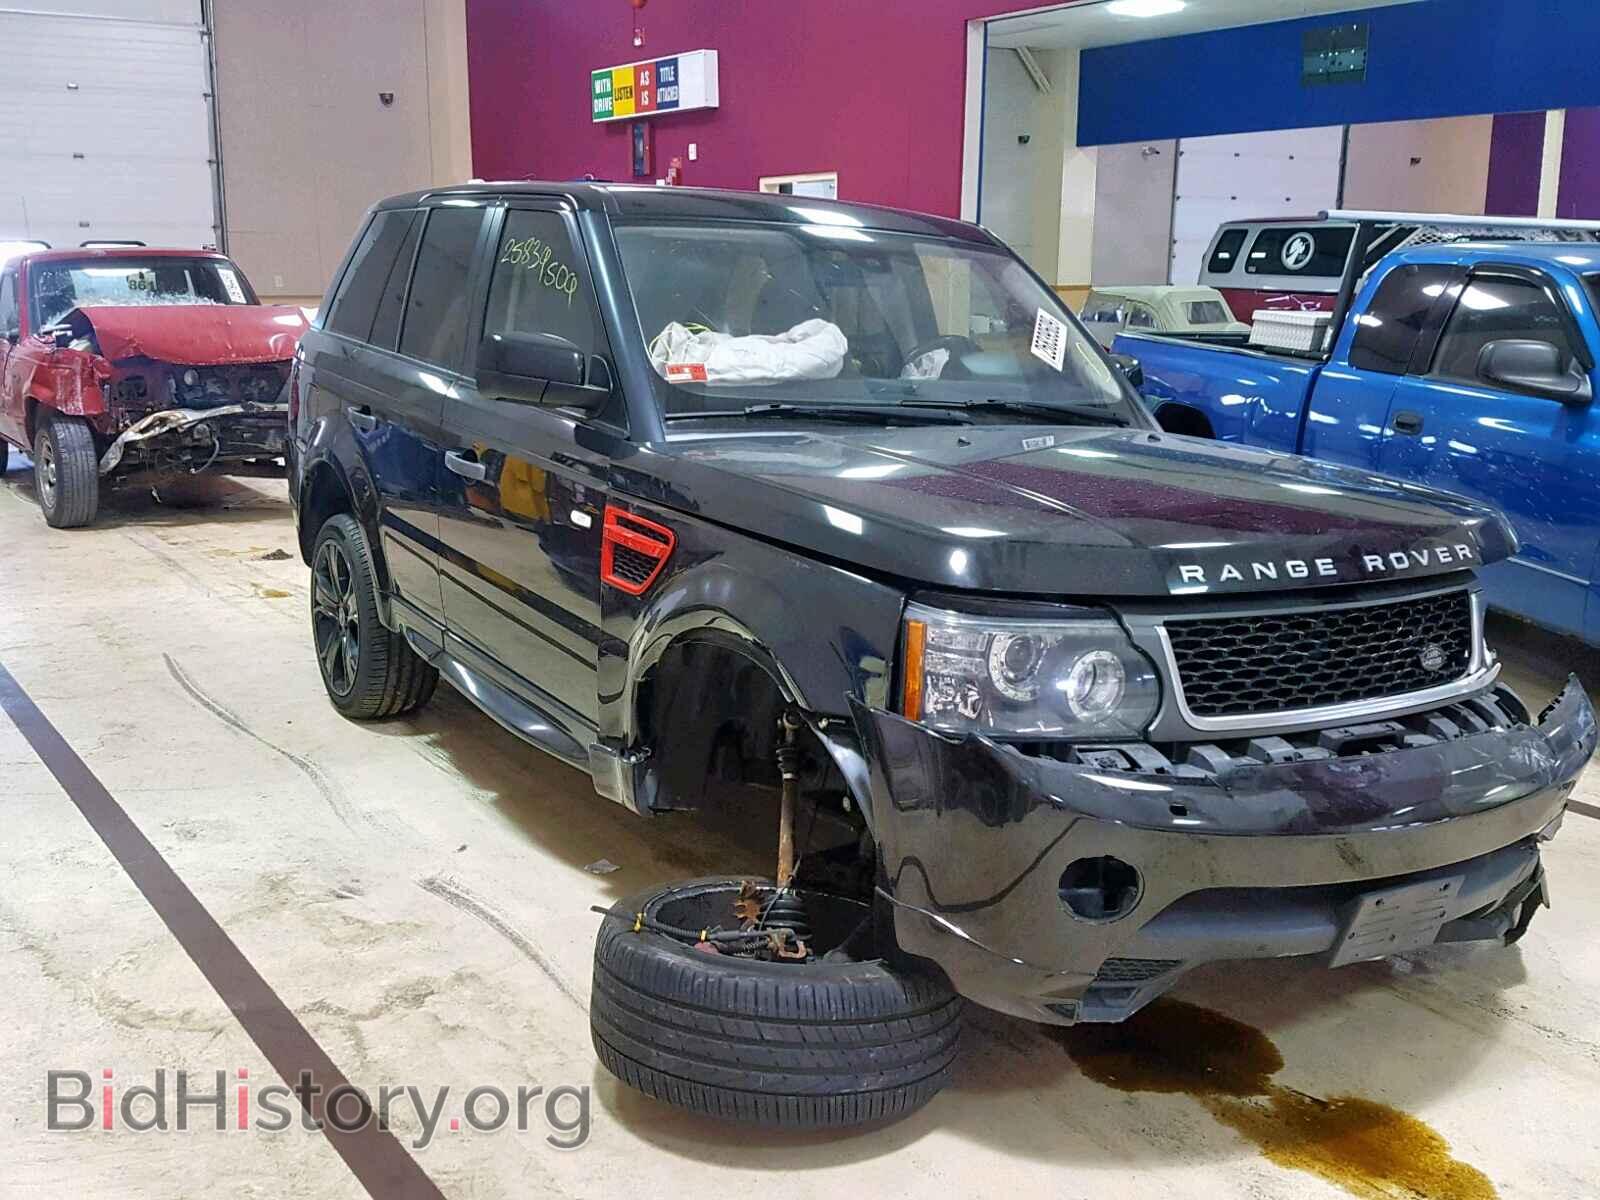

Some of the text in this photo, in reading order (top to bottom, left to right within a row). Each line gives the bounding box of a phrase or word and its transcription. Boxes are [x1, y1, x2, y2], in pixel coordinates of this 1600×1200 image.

[640, 71, 650, 86] AS
[659, 65, 675, 83] TITLE
[594, 78, 612, 94] WITH
[614, 85, 633, 102] LISTEN
[594, 96, 613, 113] DRIVE
[641, 90, 649, 106] IS
[501, 237, 577, 305] 25839509
[1179, 544, 1473, 583] RANGE ROVER
